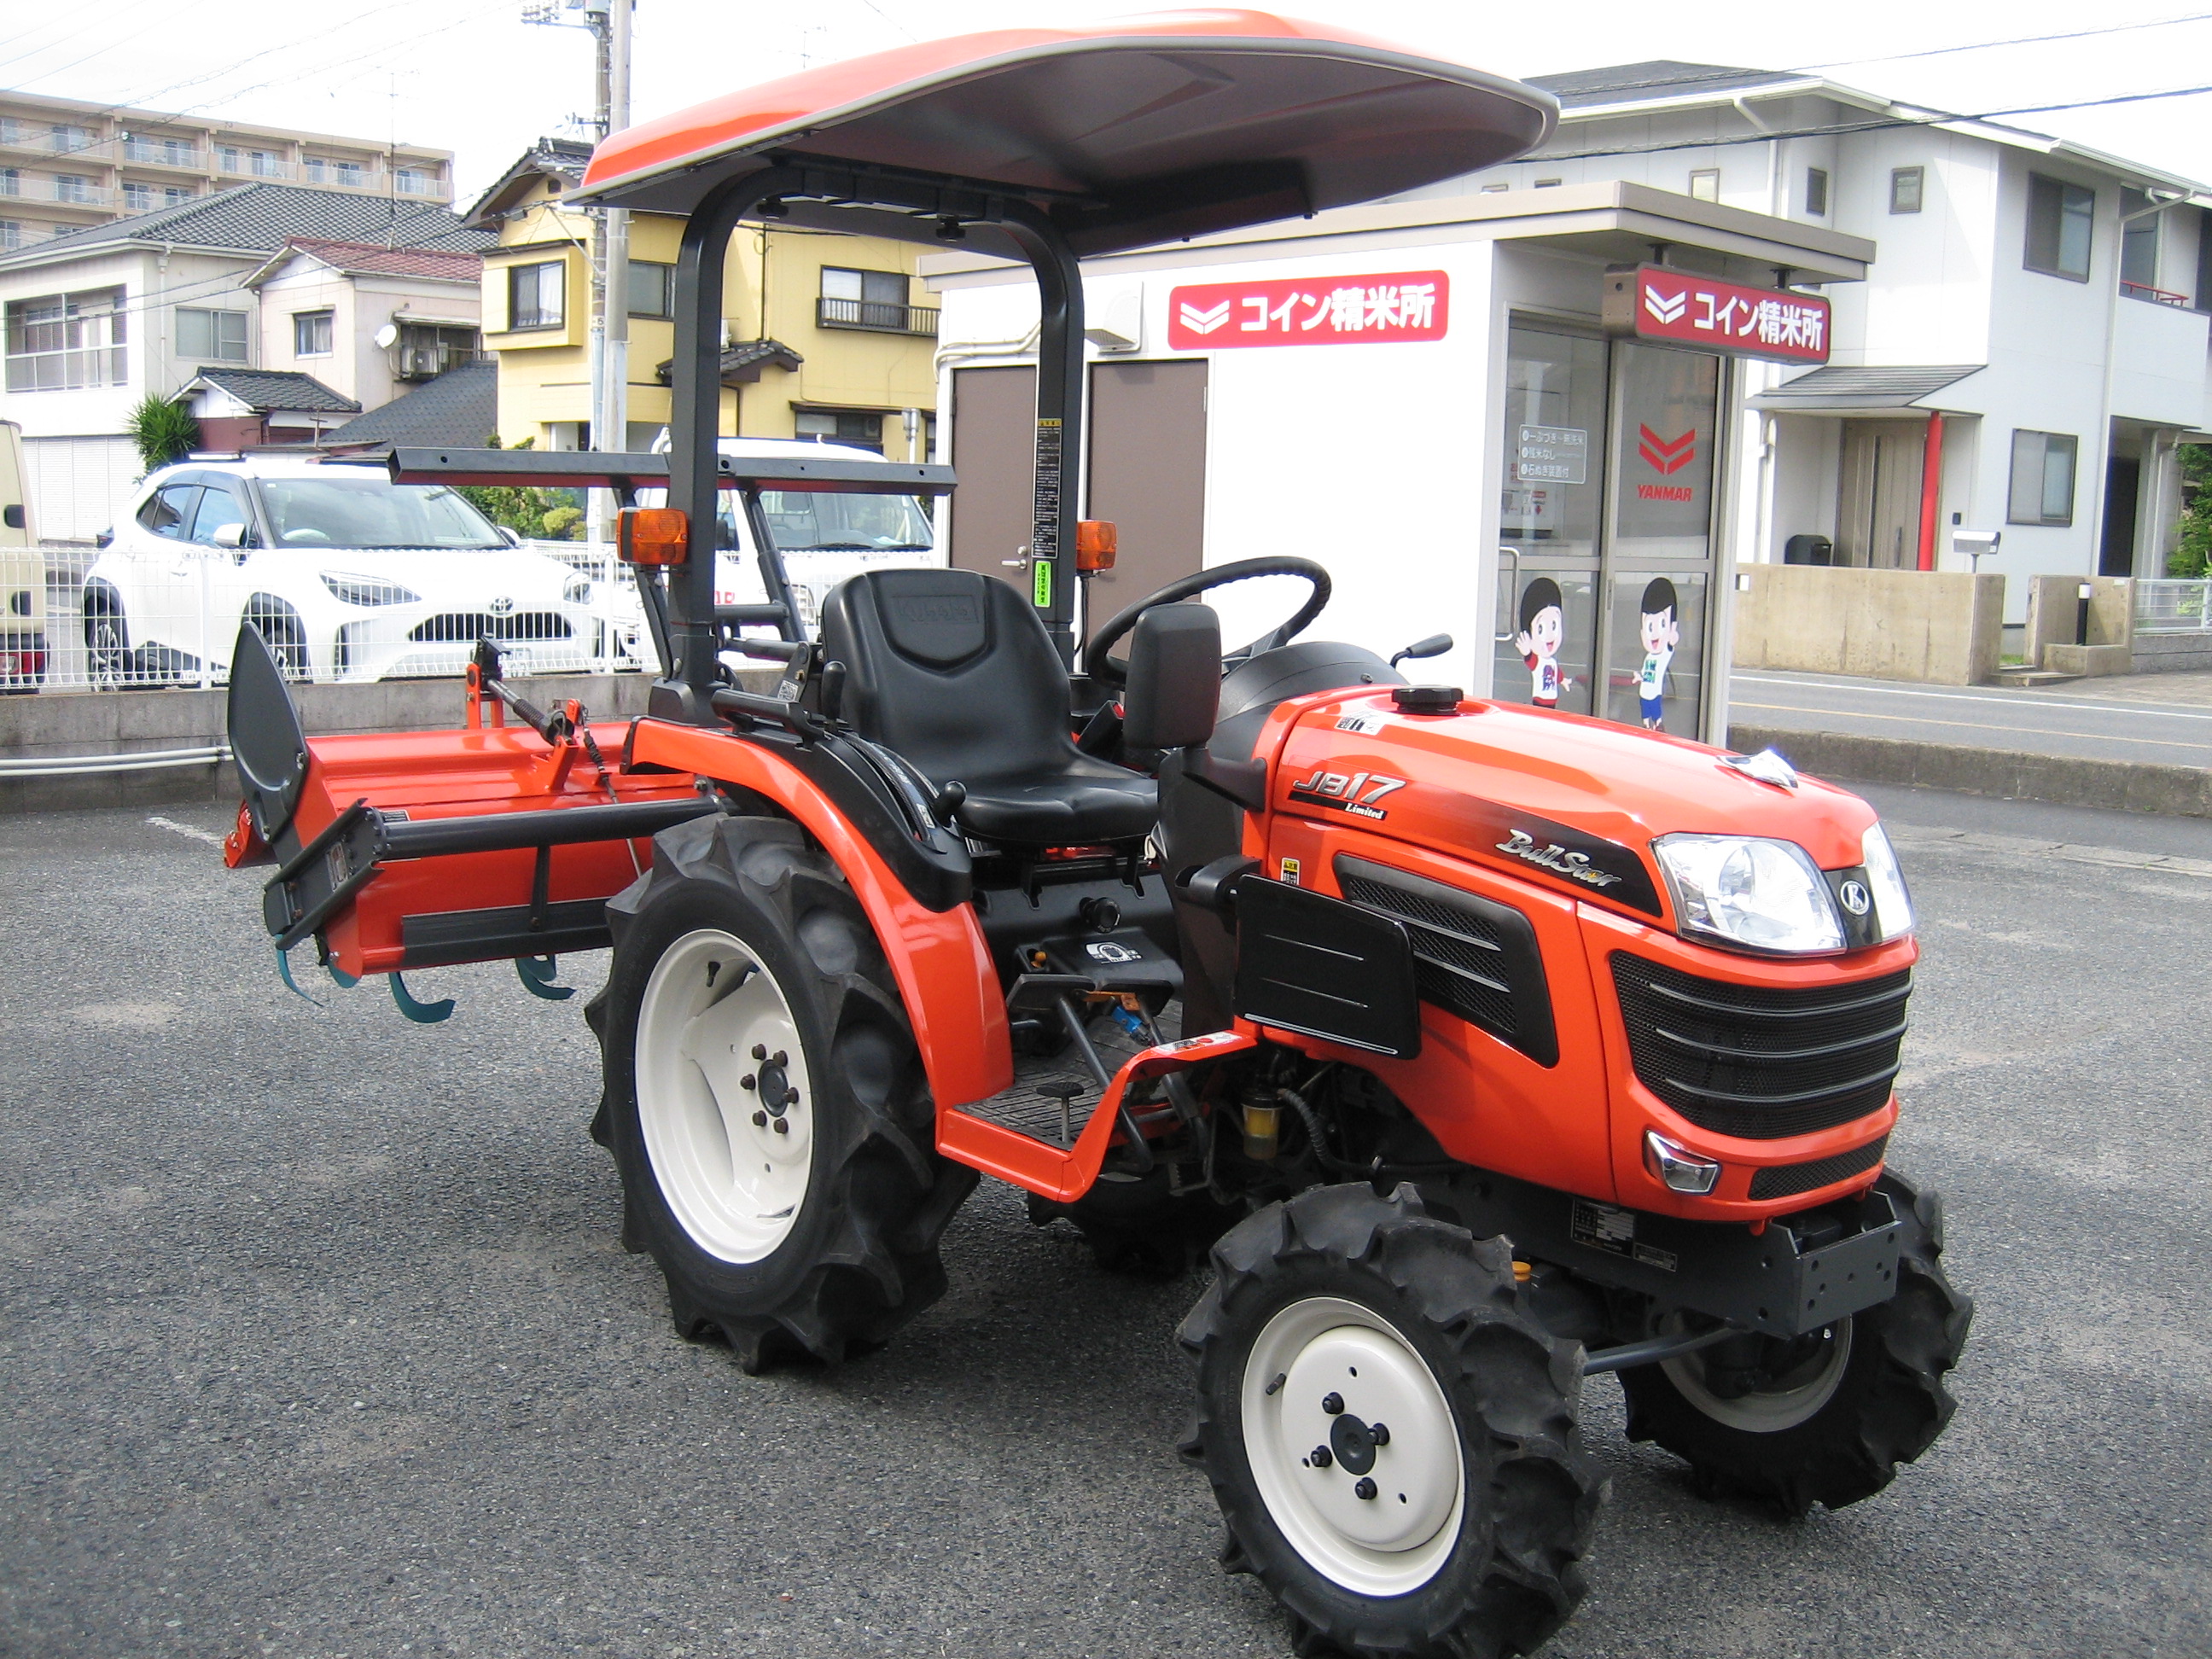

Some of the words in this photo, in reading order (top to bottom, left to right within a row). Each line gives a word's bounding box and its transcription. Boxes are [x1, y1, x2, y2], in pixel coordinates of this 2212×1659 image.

[1240, 282, 1435, 332] コイン精米所
[1693, 294, 1823, 352] コイン精米所
[1638, 484, 1693, 502] YANMAR
[1293, 771, 1406, 804] JB17
[1344, 802, 1384, 819] Limited
